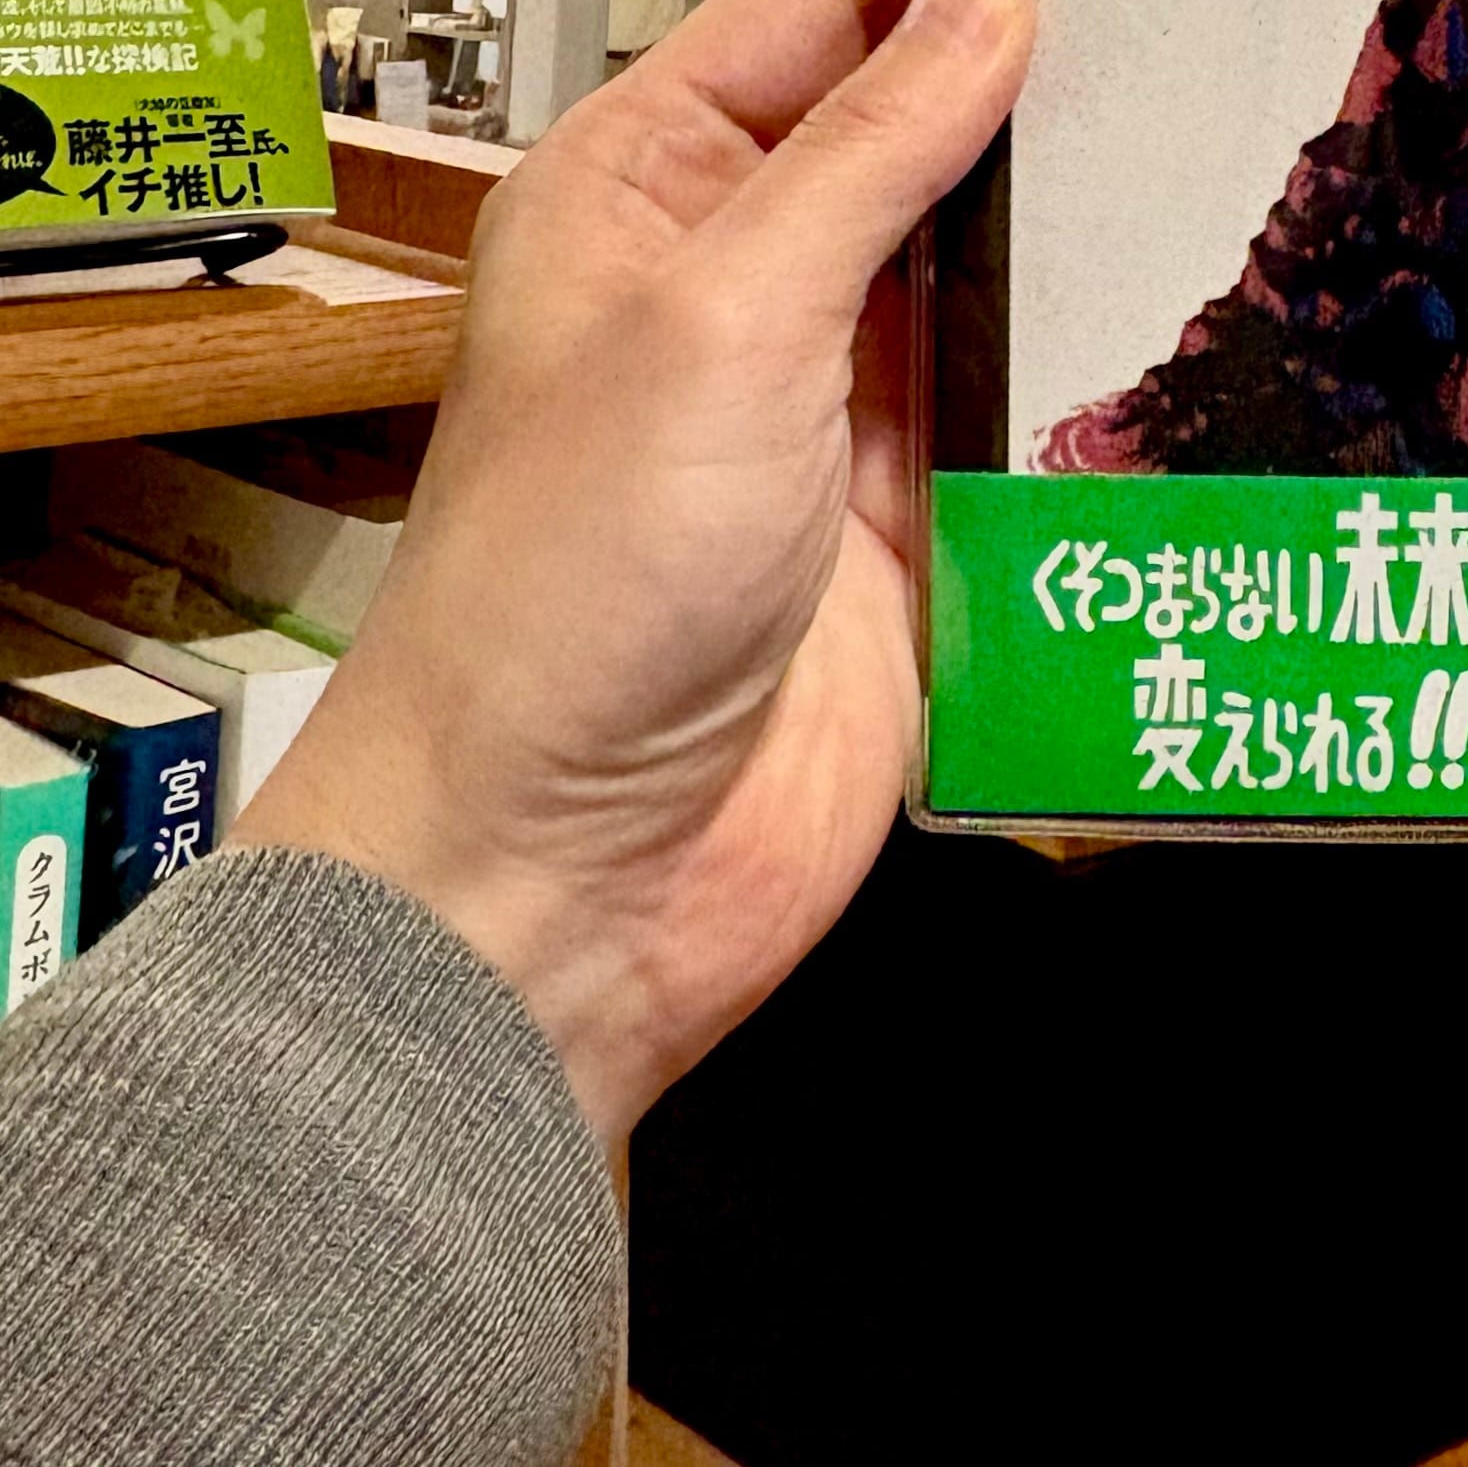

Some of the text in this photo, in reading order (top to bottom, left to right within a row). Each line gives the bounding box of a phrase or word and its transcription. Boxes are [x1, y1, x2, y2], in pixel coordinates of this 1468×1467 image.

[78, 161, 264, 216] イチ推し!
[153, 758, 207, 880] 宮沢
